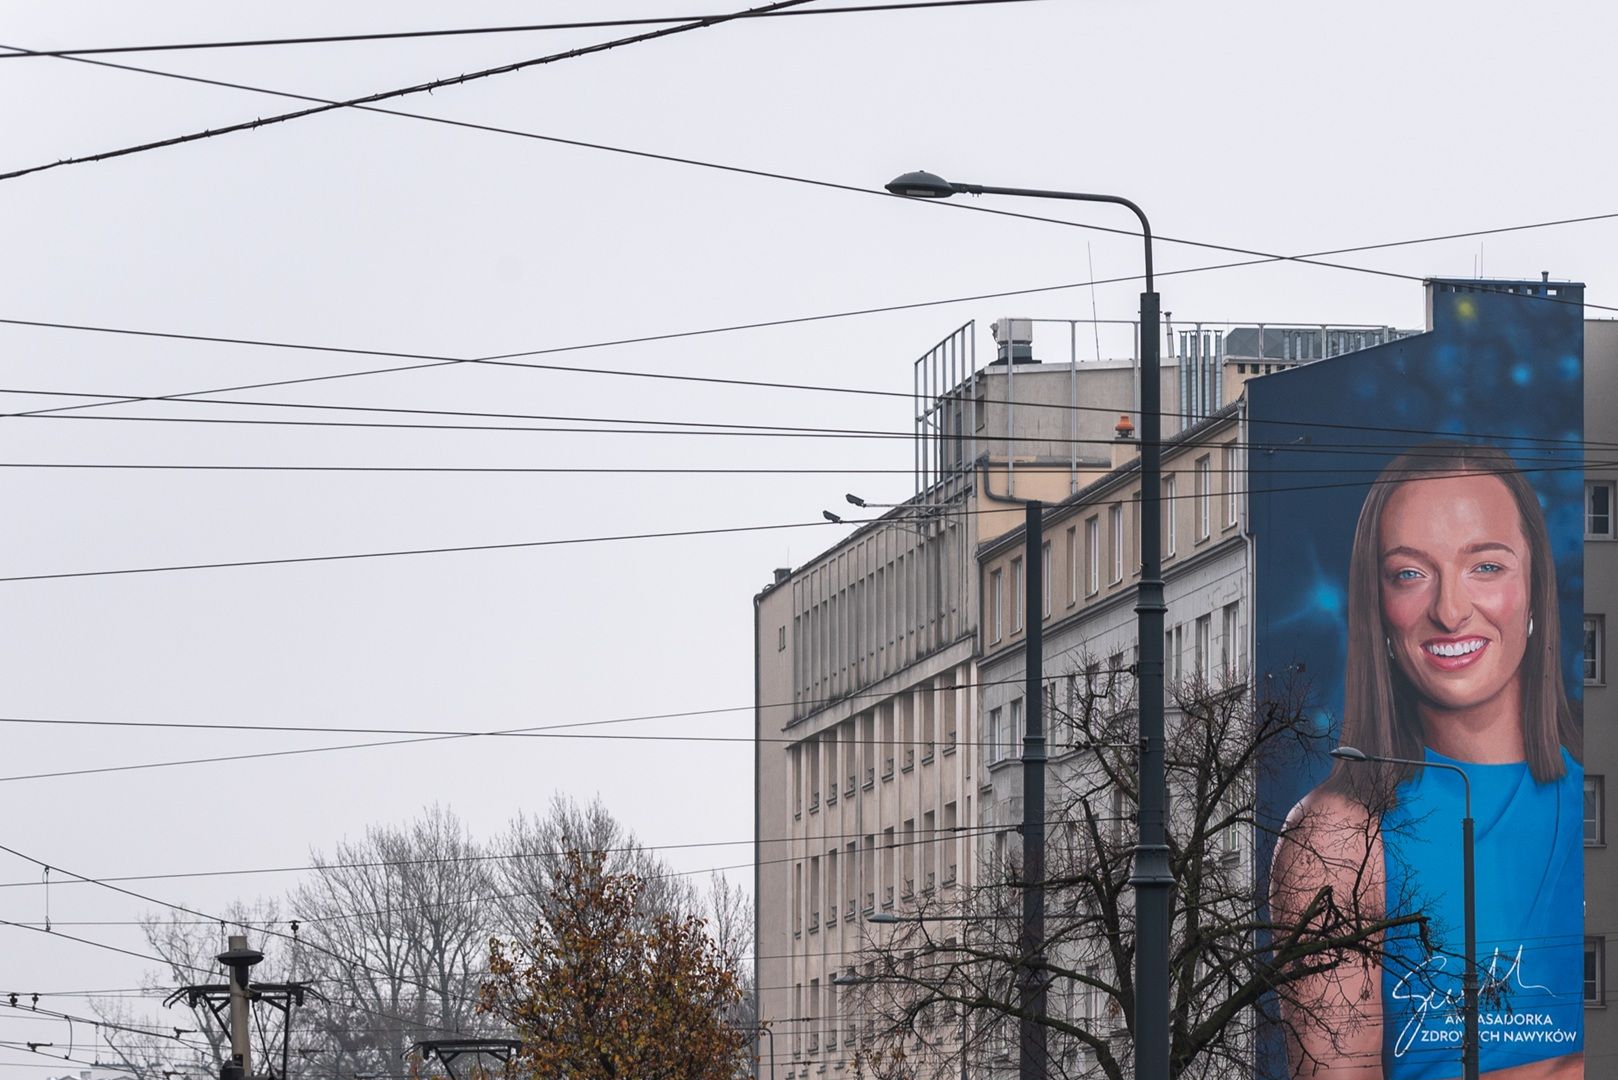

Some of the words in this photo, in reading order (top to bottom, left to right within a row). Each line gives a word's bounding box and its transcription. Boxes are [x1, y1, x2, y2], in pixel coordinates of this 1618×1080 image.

[1445, 1013, 1553, 1026] AMASADORKA
[1421, 1030, 1499, 1042] ZDROCH
[1504, 1029, 1577, 1043] NAWYKÓW
